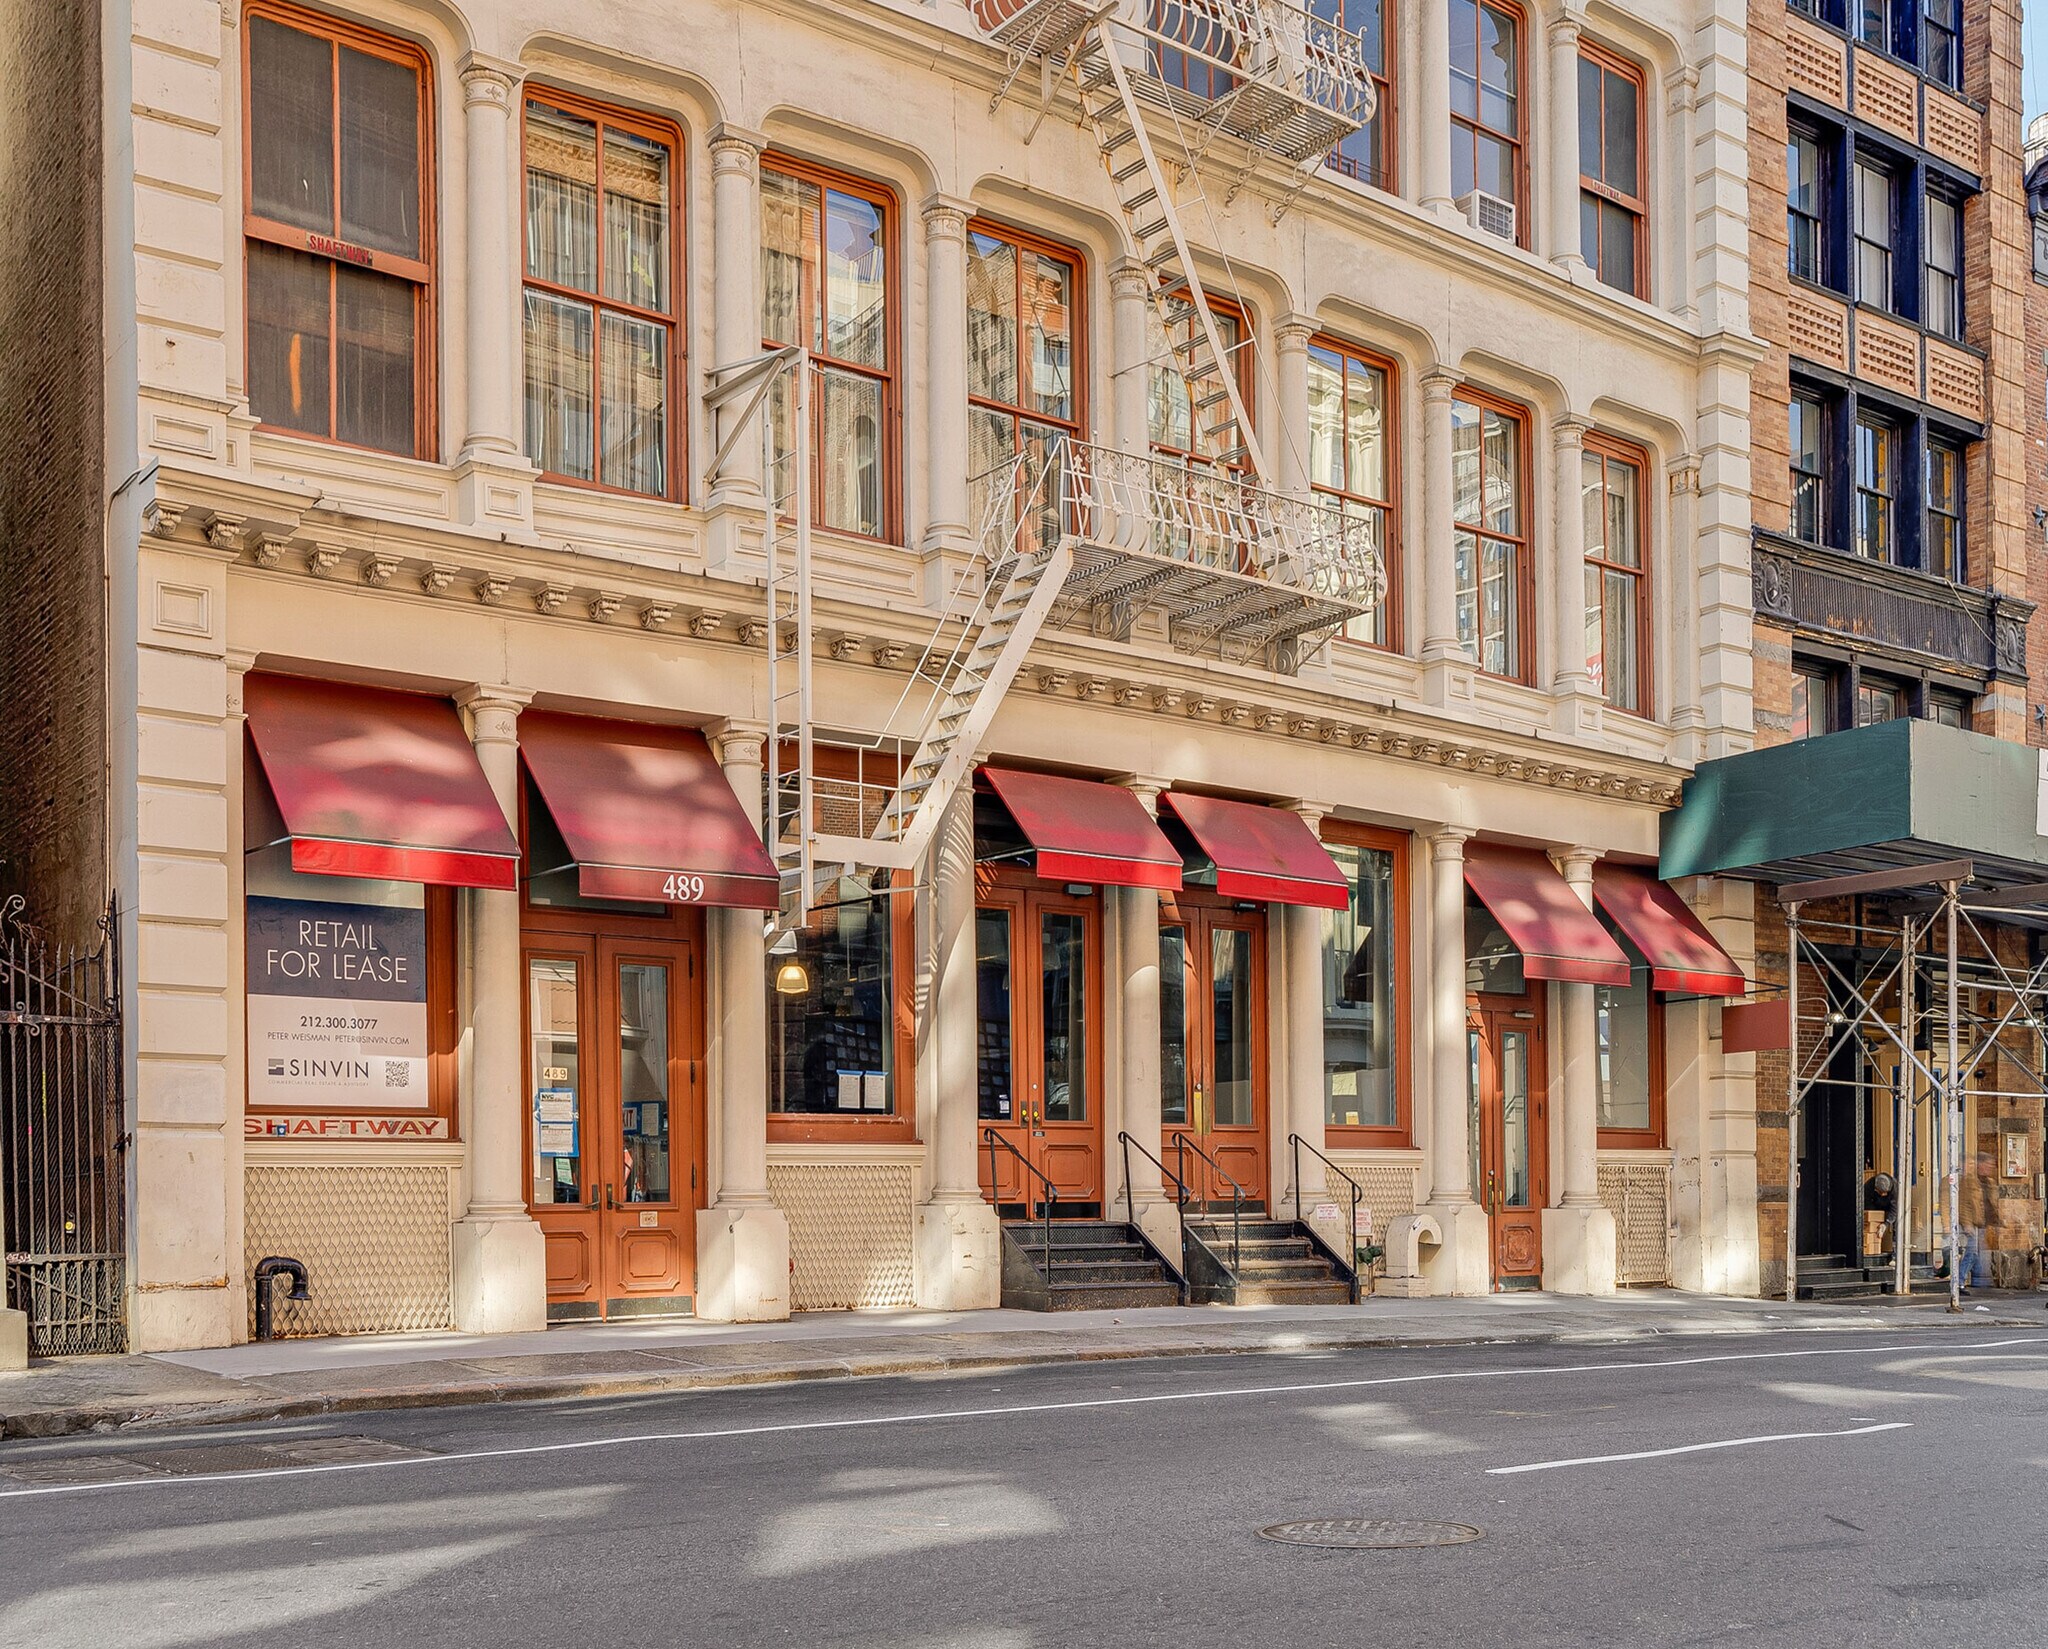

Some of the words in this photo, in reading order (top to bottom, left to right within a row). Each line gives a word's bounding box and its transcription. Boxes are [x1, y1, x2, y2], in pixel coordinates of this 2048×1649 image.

[309, 235, 369, 264] SHAFTWAY
[662, 874, 705, 902] 489
[299, 919, 378, 951] RETAIL
[267, 949, 321, 977] FOR
[333, 953, 407, 983] LEASE
[300, 1015, 378, 1030] 212.300.3077
[267, 1032, 289, 1040] PETER
[291, 1033, 331, 1042] WEISMAN
[335, 1034, 410, 1045] PETER@SINVIN.COM
[289, 1059, 369, 1079] SINVIN
[544, 1068, 567, 1079] 489
[244, 1119, 440, 1135] SHAFTWAY
